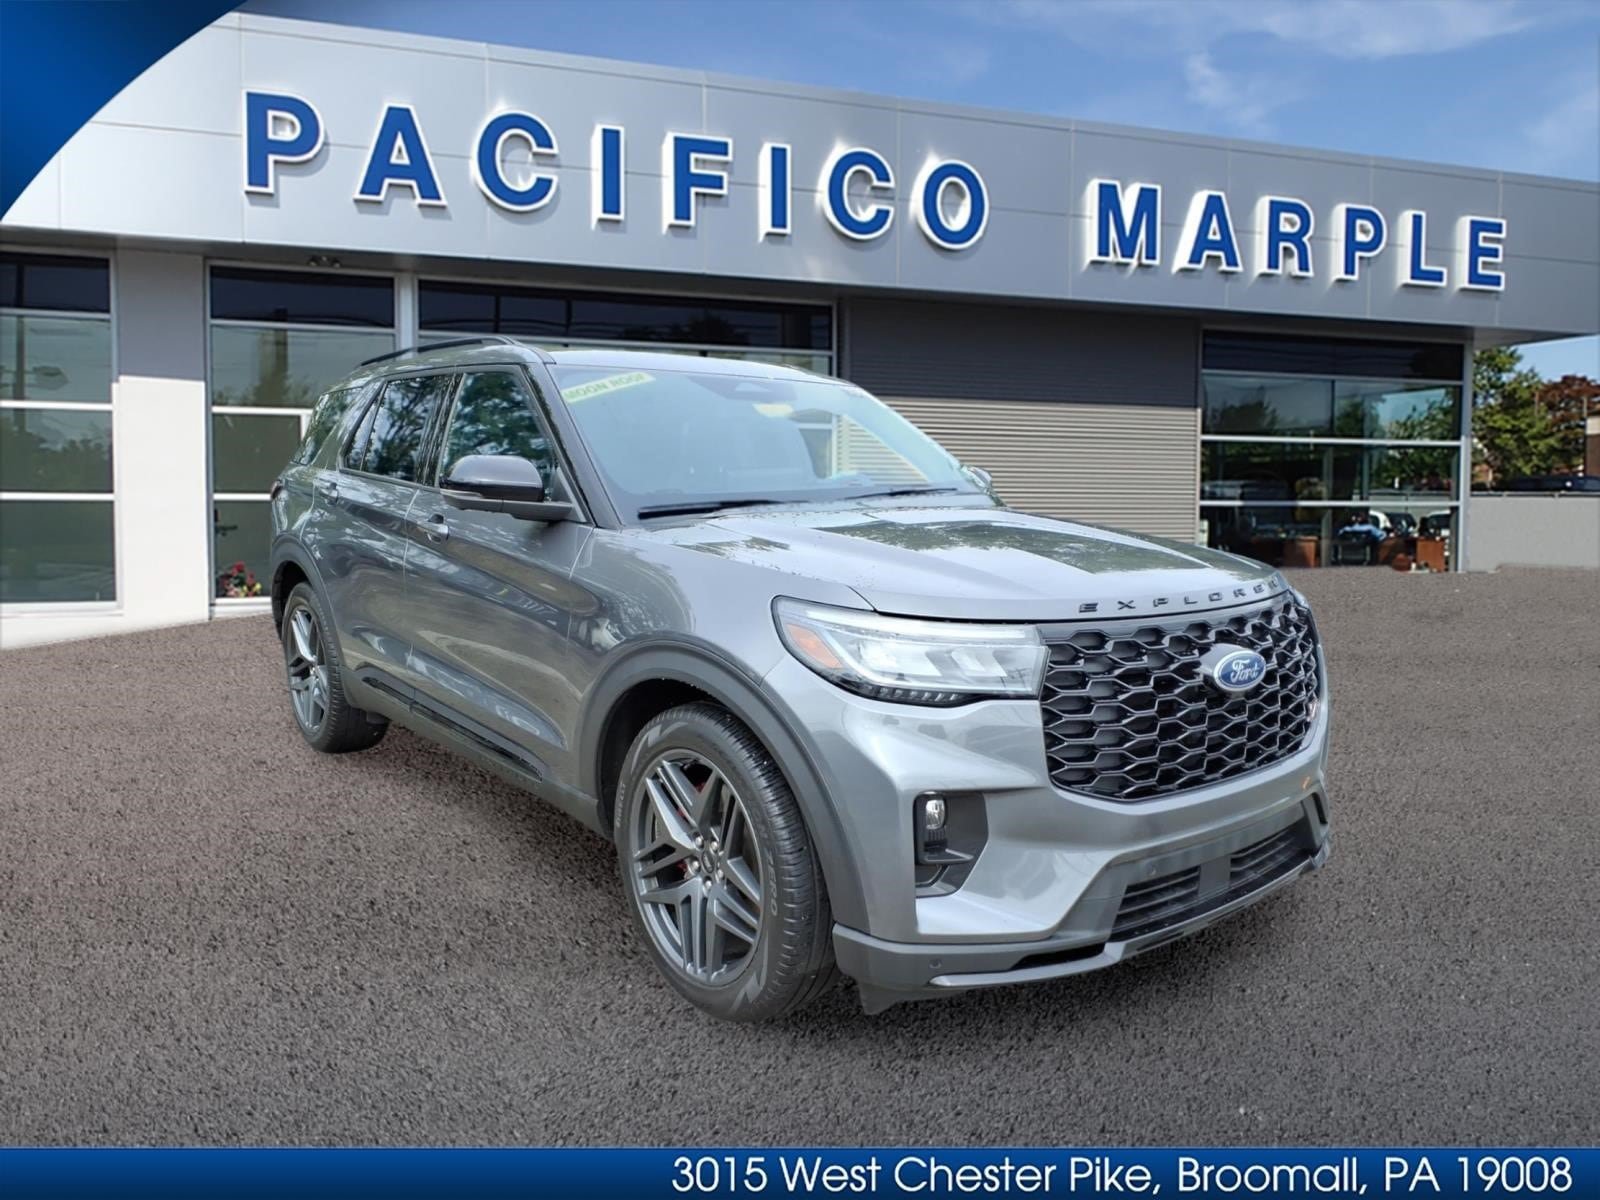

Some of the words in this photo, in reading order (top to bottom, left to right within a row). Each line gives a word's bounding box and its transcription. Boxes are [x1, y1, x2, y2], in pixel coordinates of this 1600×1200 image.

[244, 90, 988, 248] PACIFICO
[1094, 180, 1506, 290] MARPLE
[1078, 576, 1278, 613] EXPLORER
[1230, 658, 1258, 683] Ford
